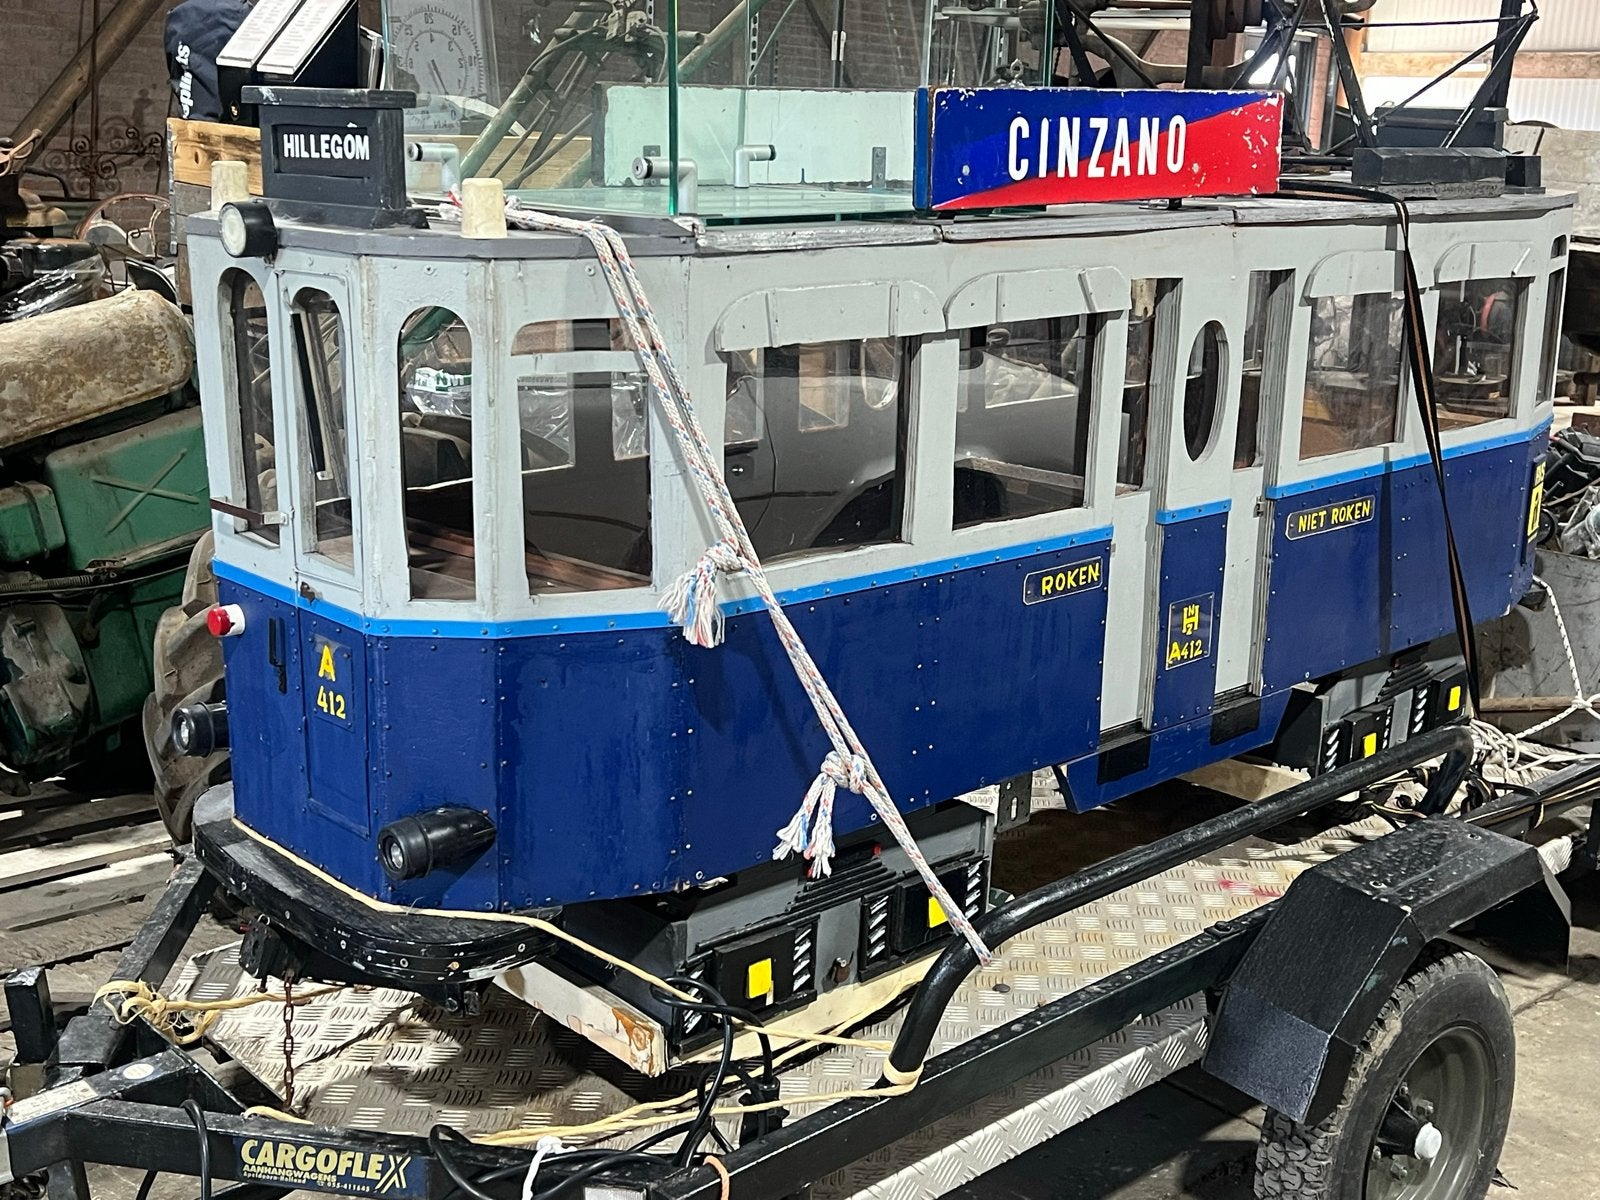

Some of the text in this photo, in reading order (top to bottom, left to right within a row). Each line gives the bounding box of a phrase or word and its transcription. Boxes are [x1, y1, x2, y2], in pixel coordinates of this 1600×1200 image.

[283, 134, 370, 160] HILLEGOM
[1008, 114, 1187, 181] CINZANO
[1298, 500, 1371, 533] NIET ROKEN
[1041, 562, 1100, 596] ROKEN
[318, 644, 336, 682] A
[317, 685, 346, 720] 412
[241, 1139, 411, 1194] CARGOFLEX
[243, 1164, 337, 1182] AANHANGWAGENS
